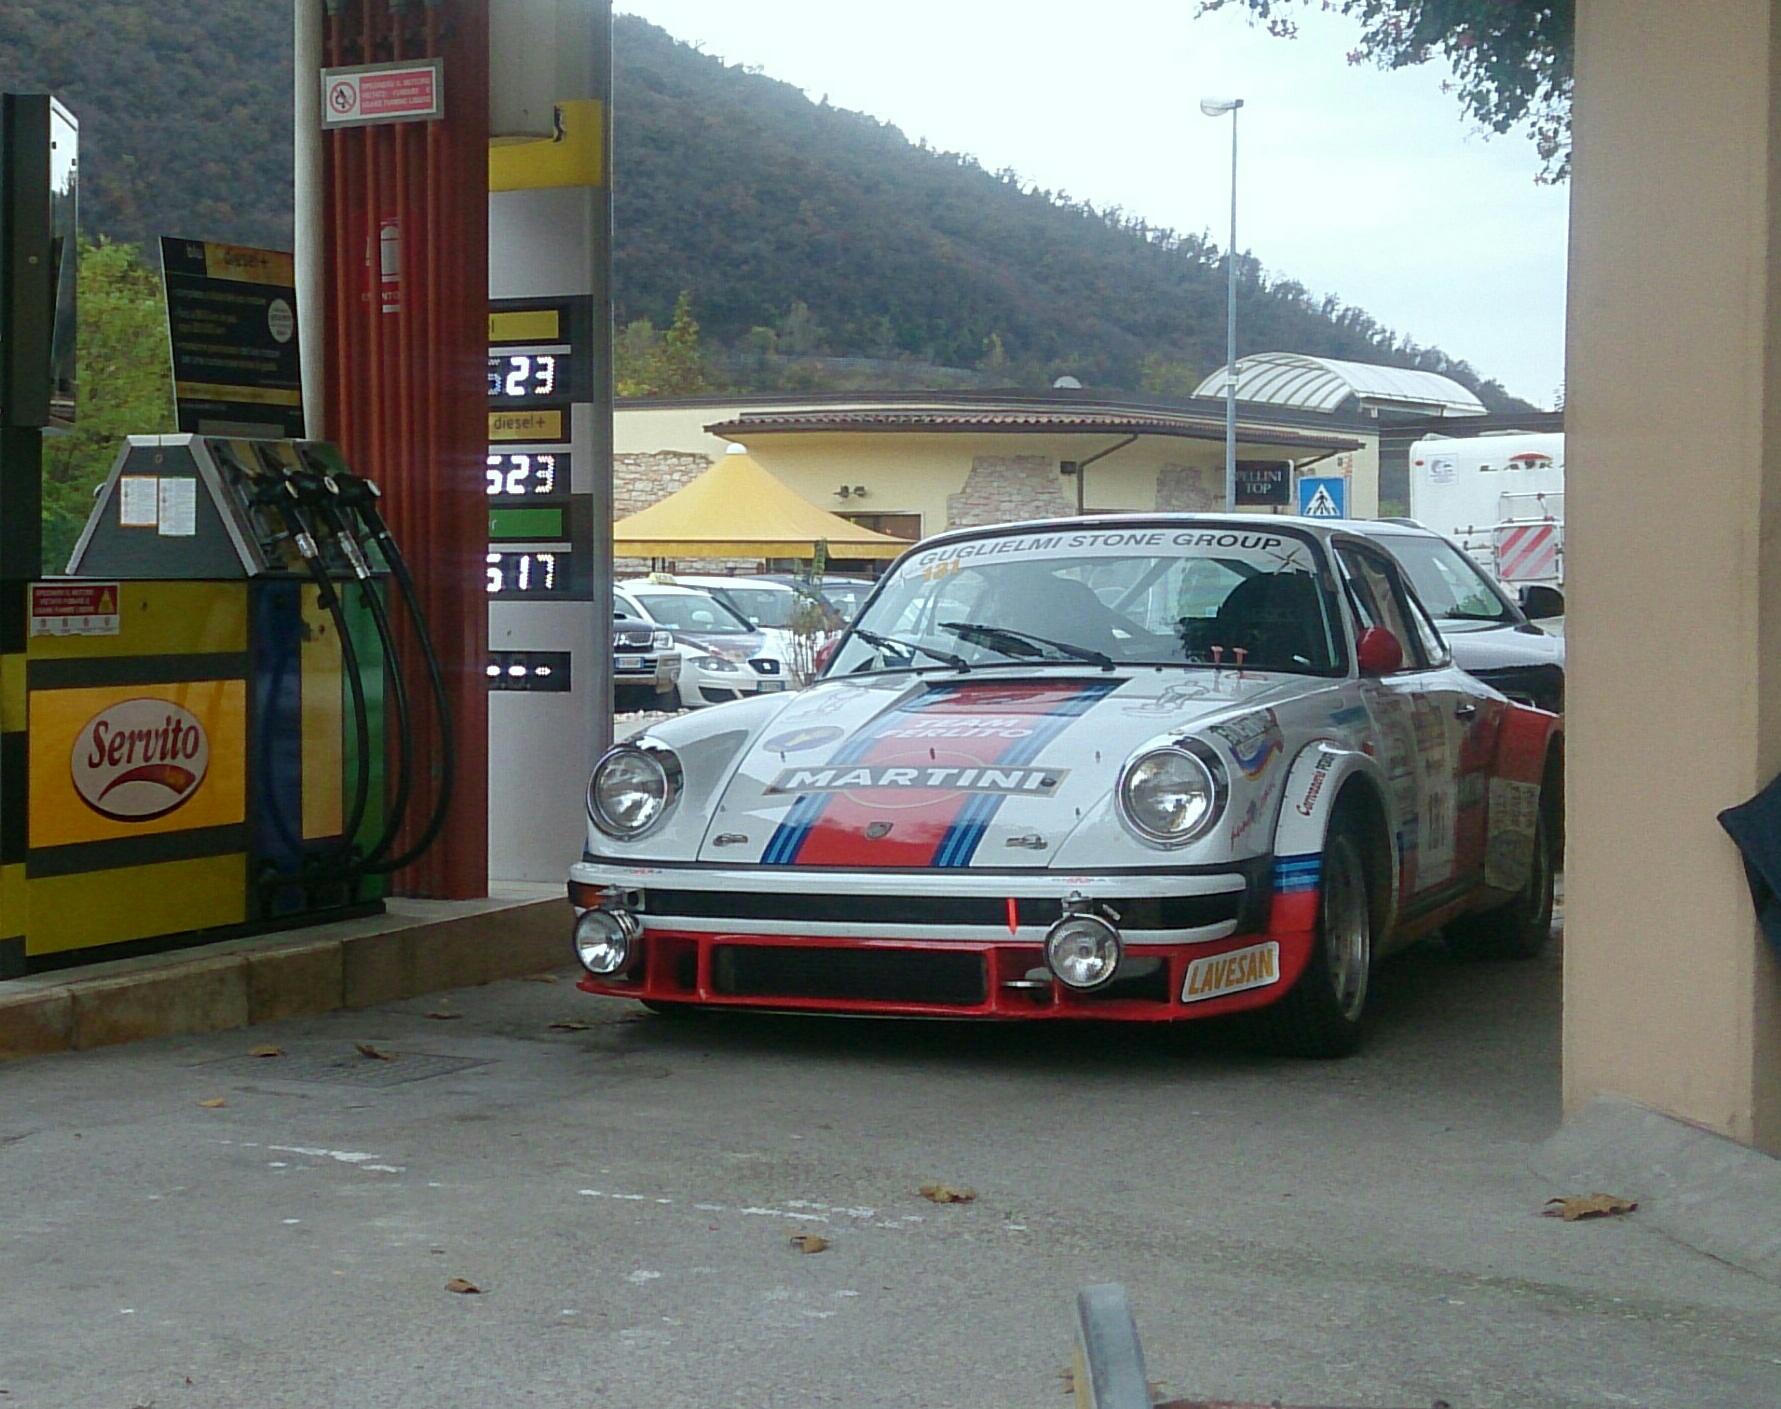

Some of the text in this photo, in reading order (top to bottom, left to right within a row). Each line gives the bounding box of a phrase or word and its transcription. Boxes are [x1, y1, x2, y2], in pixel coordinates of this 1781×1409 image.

[1245, 483, 1272, 494] TOP
[919, 533, 1282, 566] GUGLIELMI STONE GROUP
[915, 719, 1020, 728] TEAM
[88, 715, 200, 769] Servito
[786, 768, 1046, 790] MARTINI
[1188, 947, 1274, 995] LAVESAN
